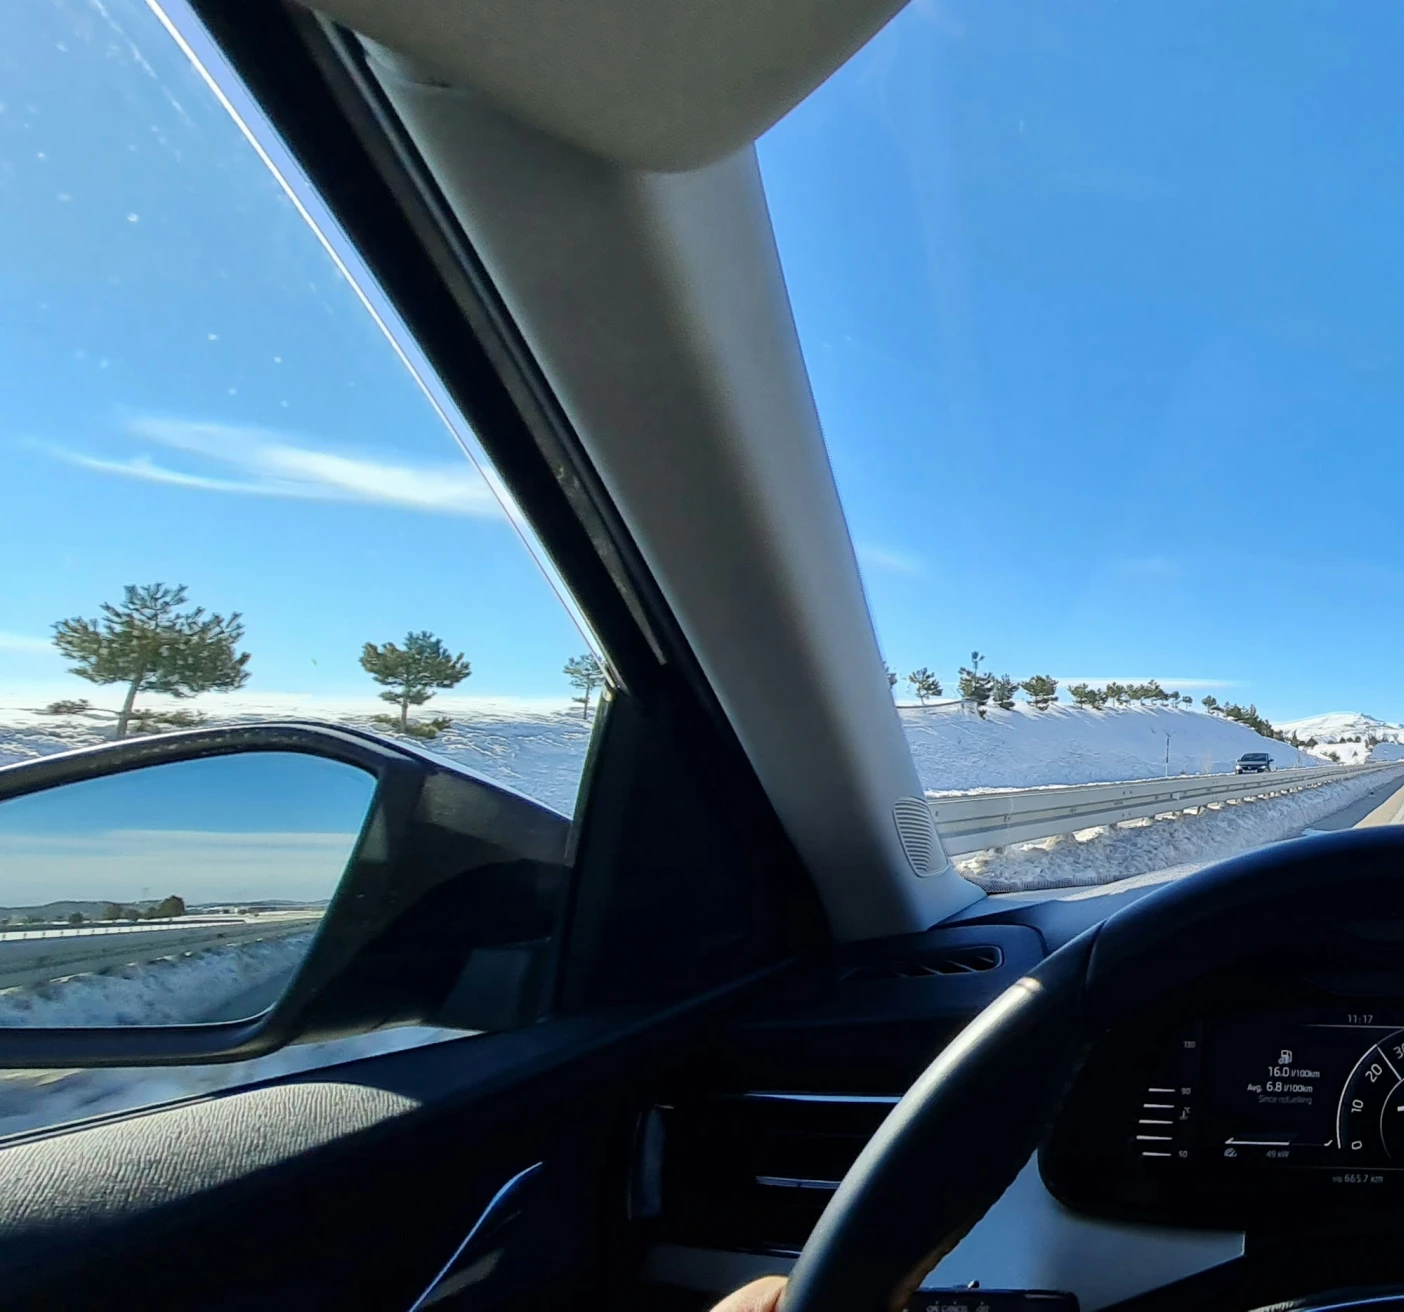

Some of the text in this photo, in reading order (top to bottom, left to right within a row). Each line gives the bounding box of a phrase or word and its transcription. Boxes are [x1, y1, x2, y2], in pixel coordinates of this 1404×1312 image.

[1348, 1014, 1374, 1024] 11:17
[1268, 1066, 1290, 1077] 16.0
[1365, 1063, 1383, 1083] 20
[1247, 1083, 1262, 1093] Avg.
[1266, 1081, 1282, 1092] 6.8
[1351, 1099, 1364, 1113] 10
[1351, 1140, 1363, 1150] 0
[1370, 1174, 1384, 1184] km
